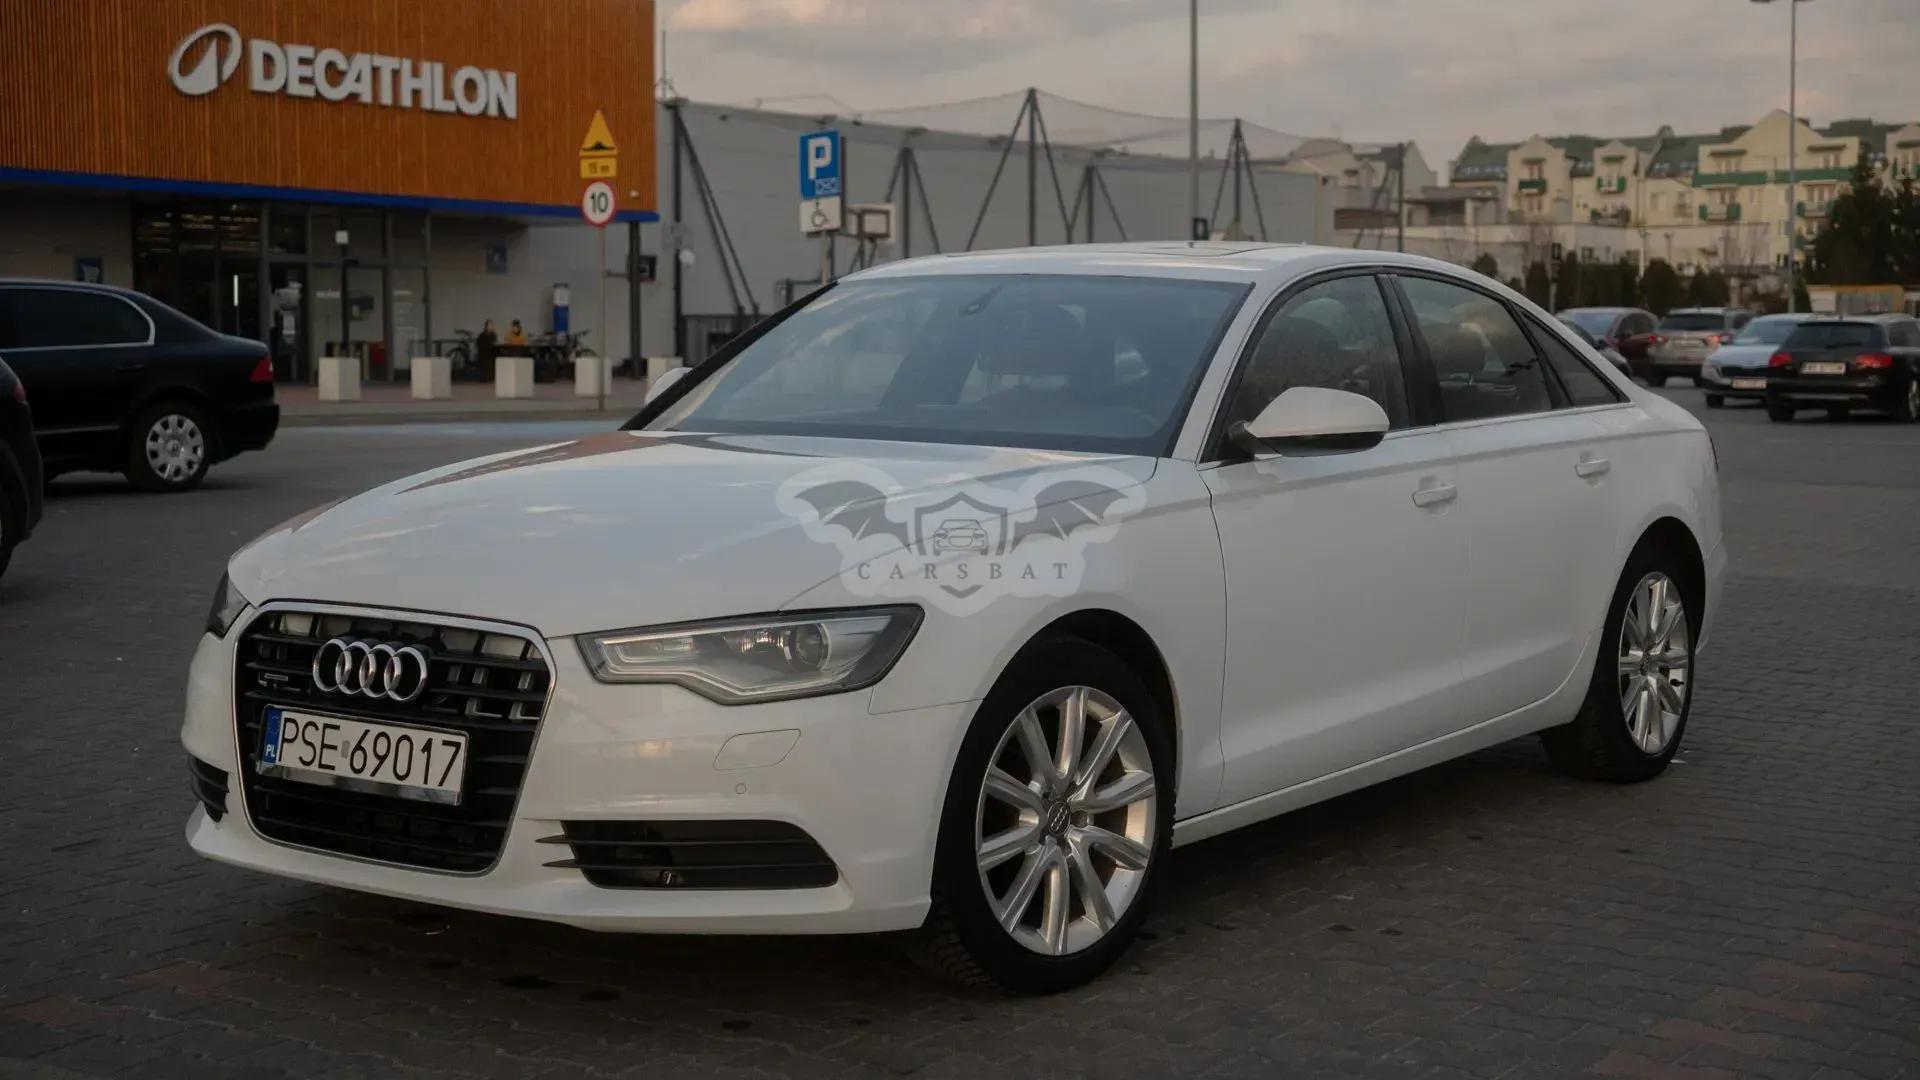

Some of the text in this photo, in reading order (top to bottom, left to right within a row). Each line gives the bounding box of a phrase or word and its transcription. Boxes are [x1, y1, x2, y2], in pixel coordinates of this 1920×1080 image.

[250, 39, 517, 119] DECATHLON
[808, 136, 832, 180] P
[590, 191, 608, 214] 10
[265, 744, 276, 758] PL
[278, 717, 462, 787] PSE 69017
